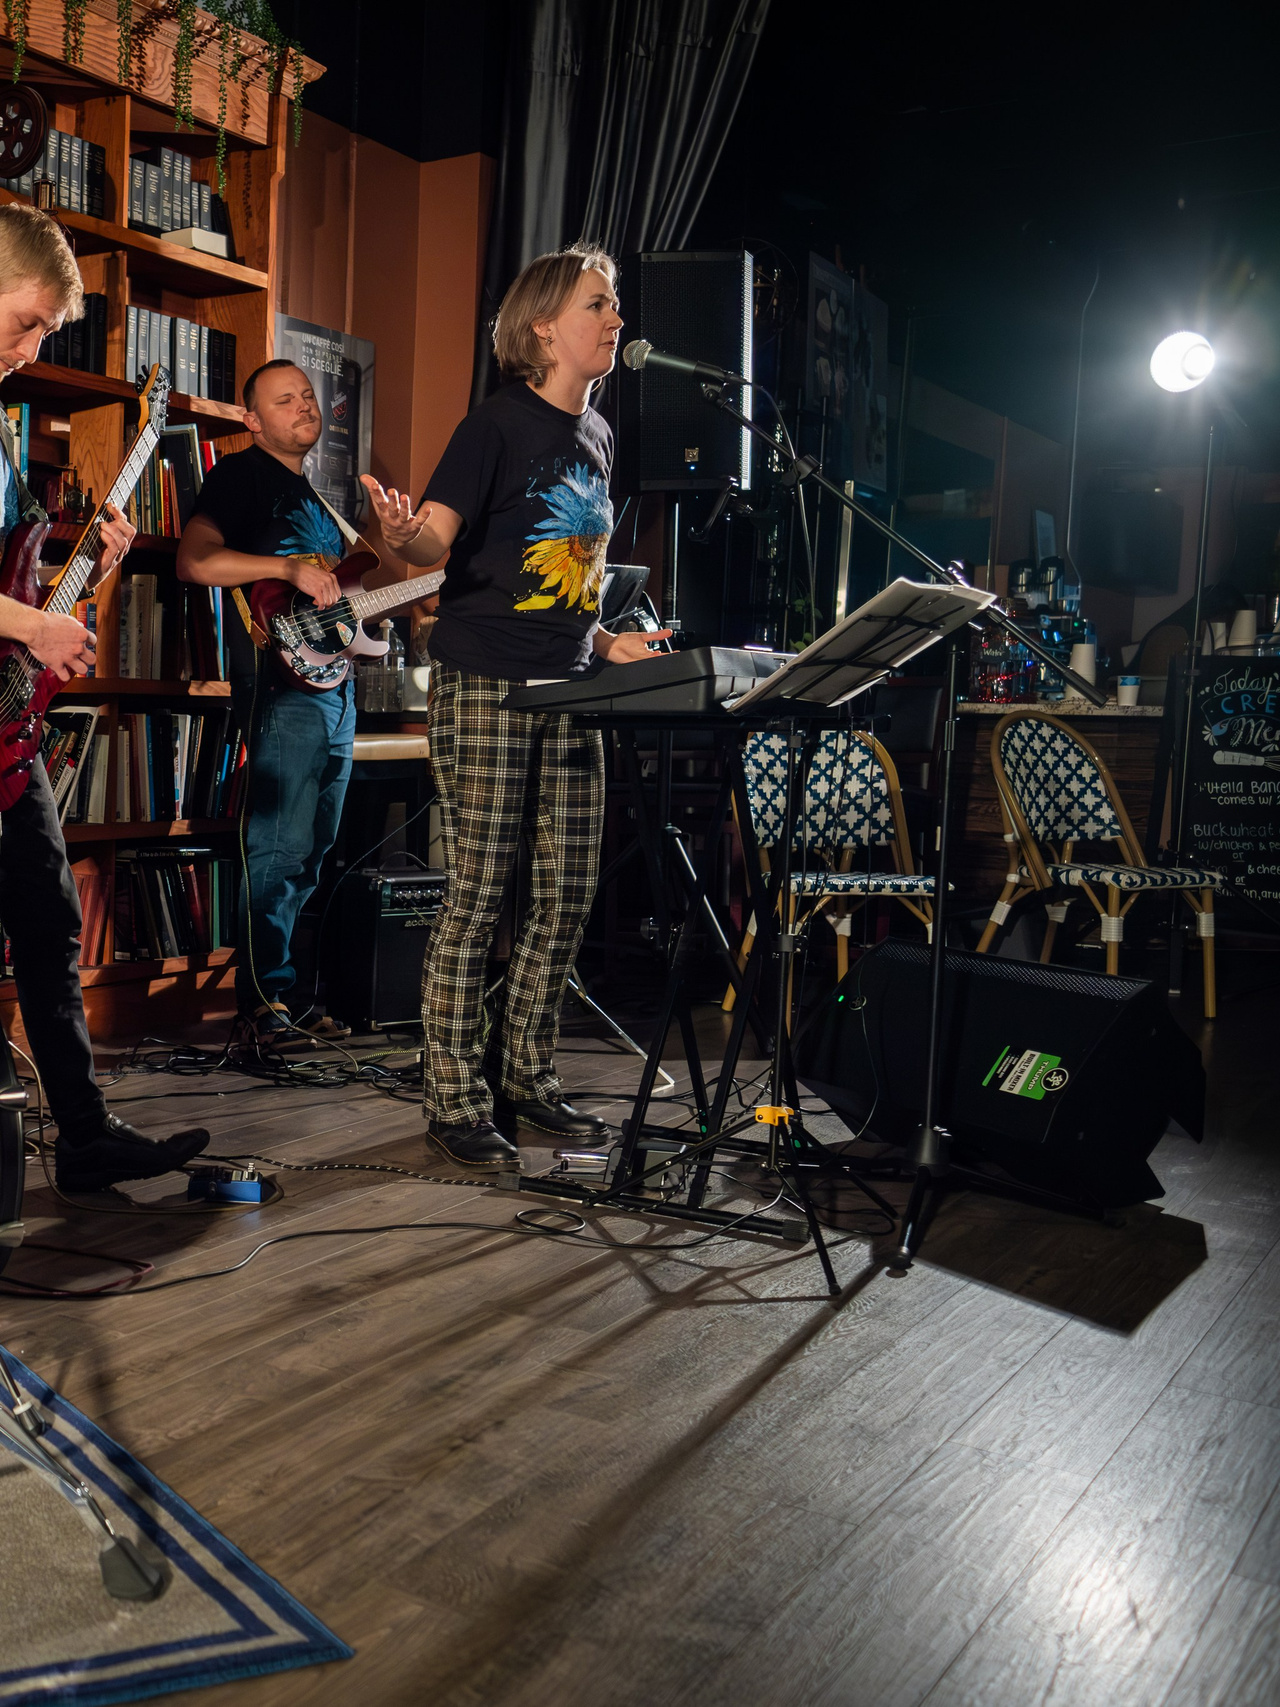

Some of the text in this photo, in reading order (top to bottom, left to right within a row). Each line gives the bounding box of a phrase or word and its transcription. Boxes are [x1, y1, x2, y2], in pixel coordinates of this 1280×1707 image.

[302, 333, 311, 344] UN
[313, 336, 331, 351] CAFFÈ
[302, 355, 344, 377] SI SCEGLIE.
[983, 648, 1004, 656] Water
[1221, 694, 1278, 714] CRE
[1199, 781, 1244, 794] utella
[1232, 851, 1244, 859] or
[1017, 1053, 1036, 1075] BUILT-IN
[1007, 1075, 1022, 1091] MIXER
[1026, 1060, 1049, 1090] THUMP
